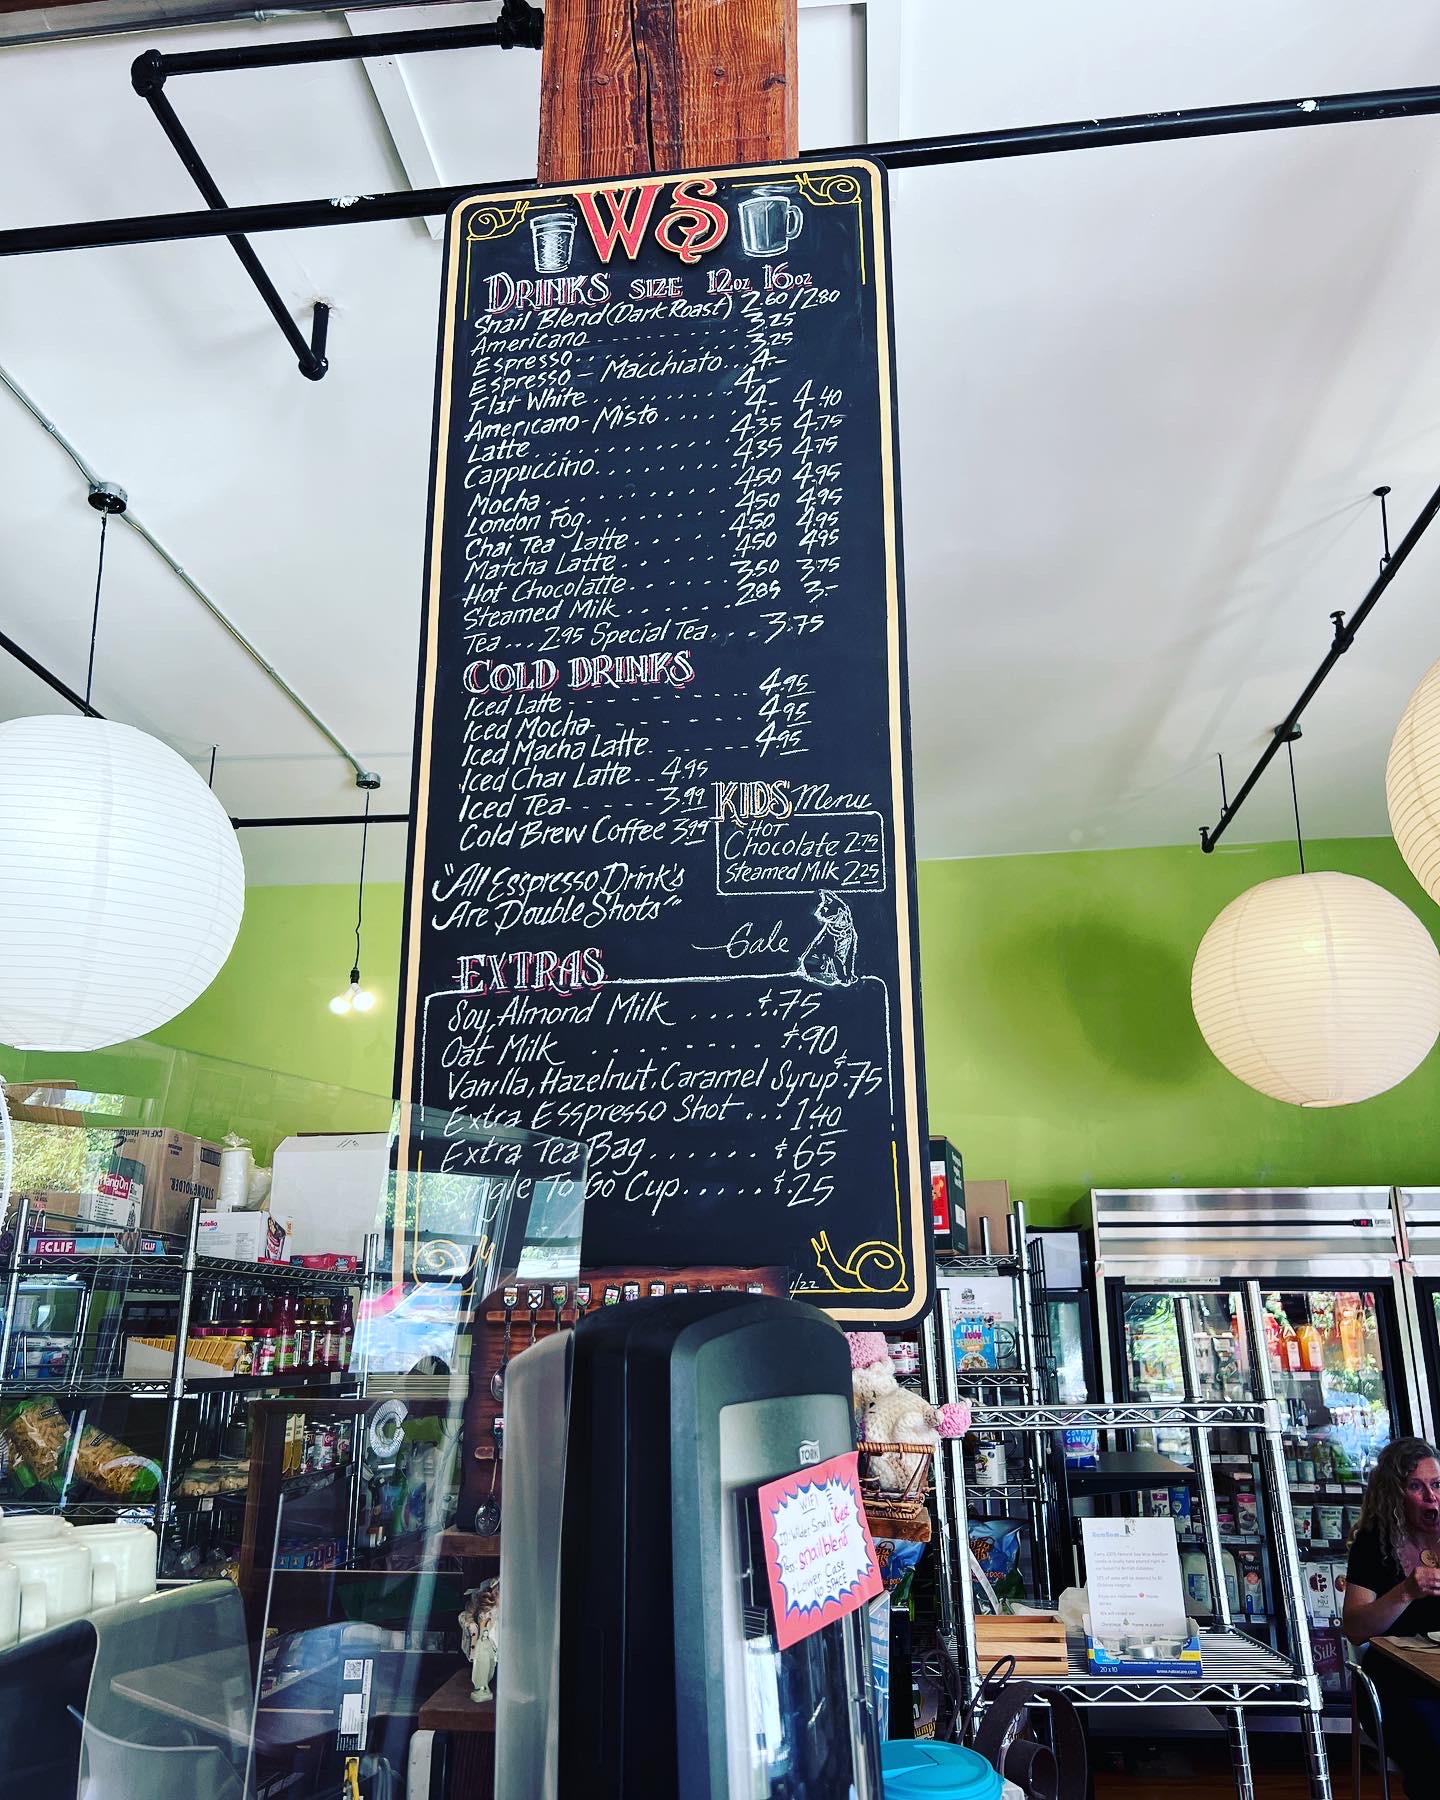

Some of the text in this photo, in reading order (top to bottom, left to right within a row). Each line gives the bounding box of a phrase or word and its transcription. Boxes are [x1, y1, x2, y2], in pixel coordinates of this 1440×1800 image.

[474, 310, 533, 338] Snail
[537, 301, 611, 331] Blend
[607, 300, 670, 327] (Dark
[668, 292, 734, 320] Roast)
[483, 271, 611, 315] DRINKS
[628, 276, 683, 301] SIZE
[471, 312, 796, 357] Americano 3.25
[472, 332, 794, 378] Espresso 3.25
[469, 369, 572, 398] Espresso
[600, 350, 723, 383] Macchiato
[469, 395, 522, 423] Flat
[526, 387, 588, 411] White
[591, 403, 659, 434] Misto
[792, 379, 843, 411] 4.40
[467, 409, 844, 464] Latte 4.35 4.75
[464, 436, 839, 497] Cappuccino 4.35 4.75
[467, 461, 843, 517] Mocha 4.50 4.95
[464, 512, 542, 538] London
[549, 506, 586, 539] Fog
[795, 486, 843, 513] 4.95
[465, 505, 840, 561] Chai Tea Latte 4.50 4.95
[464, 556, 550, 583] Matcha
[554, 551, 617, 575] Latte
[734, 531, 778, 558] 4.50
[462, 556, 841, 608] Hot Chocolatte 3.50 3.75
[463, 599, 565, 630] Steamed
[568, 597, 621, 620] Milk
[734, 579, 782, 607] 2.85
[463, 611, 825, 656] Tea 2.95 Special Tea 3.75
[463, 649, 696, 695] COLD DRINKS
[463, 666, 813, 720] Iced Latte 4.95
[461, 720, 806, 768] Iced Macha Latte 4.95
[462, 717, 513, 744] Iced
[514, 709, 591, 739] Mocha
[461, 756, 709, 794] Iced Chai Latte 4.95
[790, 782, 874, 812] Menu
[459, 786, 709, 823] Iced Tea 3.99
[459, 814, 710, 852] Cold Brew Coffee 3.99
[723, 830, 879, 860] Chocolate 2.75
[599, 861, 686, 896] Drink's
[724, 860, 880, 886] Steamed Milk 2.25
[431, 900, 490, 931] Are
[494, 895, 586, 936] Double
[453, 947, 608, 997] EXTRAS
[496, 992, 601, 1027] Almond
[605, 991, 677, 1026] Milk
[441, 1035, 496, 1068] Oat
[497, 1032, 566, 1066] Milk
[448, 1067, 534, 1101] Vanilla,
[661, 1057, 769, 1091] Caramel
[770, 1059, 839, 1107] Syrup
[443, 1103, 523, 1137] Extra
[531, 1100, 668, 1136] Esspresso
[672, 1092, 745, 1122] Shot
[440, 1135, 523, 1173] Extra
[532, 1135, 581, 1166] Tea
[586, 1130, 646, 1176] Bag
[542, 1171, 576, 1204] To
[583, 1171, 616, 1200] Go
[624, 1170, 681, 1217] Cup
[42, 1241, 74, 1254] CLIF
[1313, 1642, 1338, 1664] Silk
